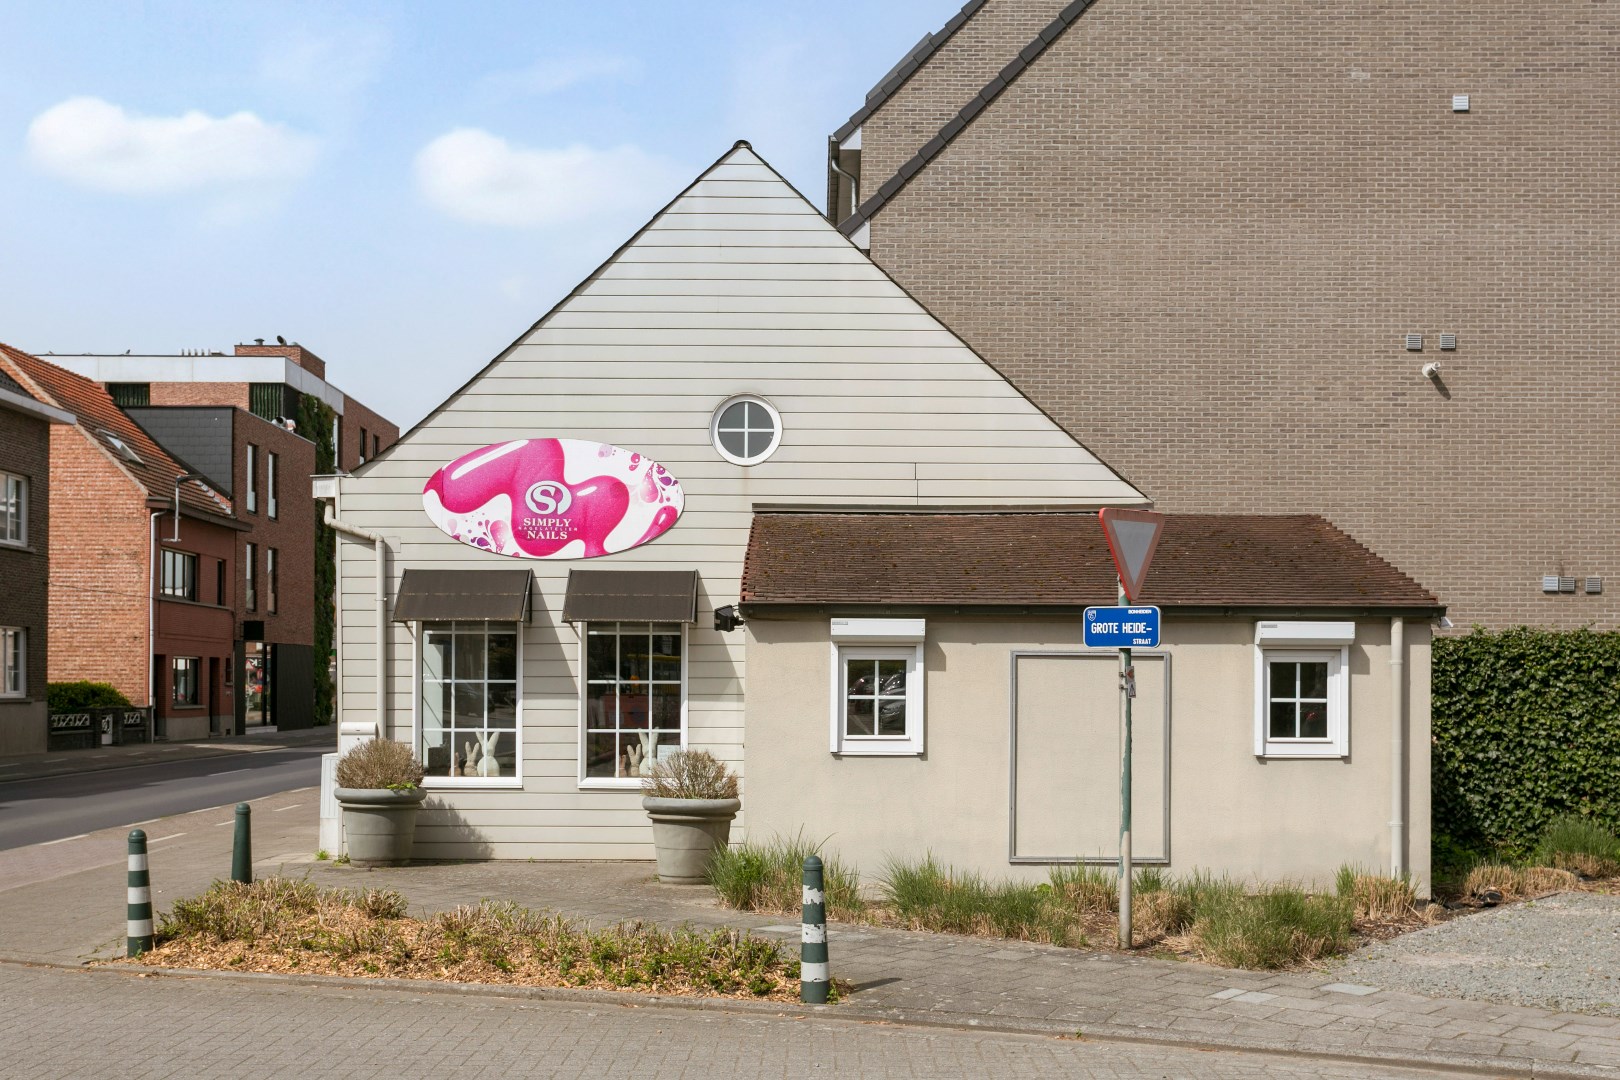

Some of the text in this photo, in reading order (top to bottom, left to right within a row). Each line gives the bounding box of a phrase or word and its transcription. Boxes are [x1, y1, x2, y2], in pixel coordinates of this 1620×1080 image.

[524, 518, 572, 526] SIMPLY
[528, 531, 568, 540] NAILS
[1091, 622, 1152, 634] GROTE HEIDE-
